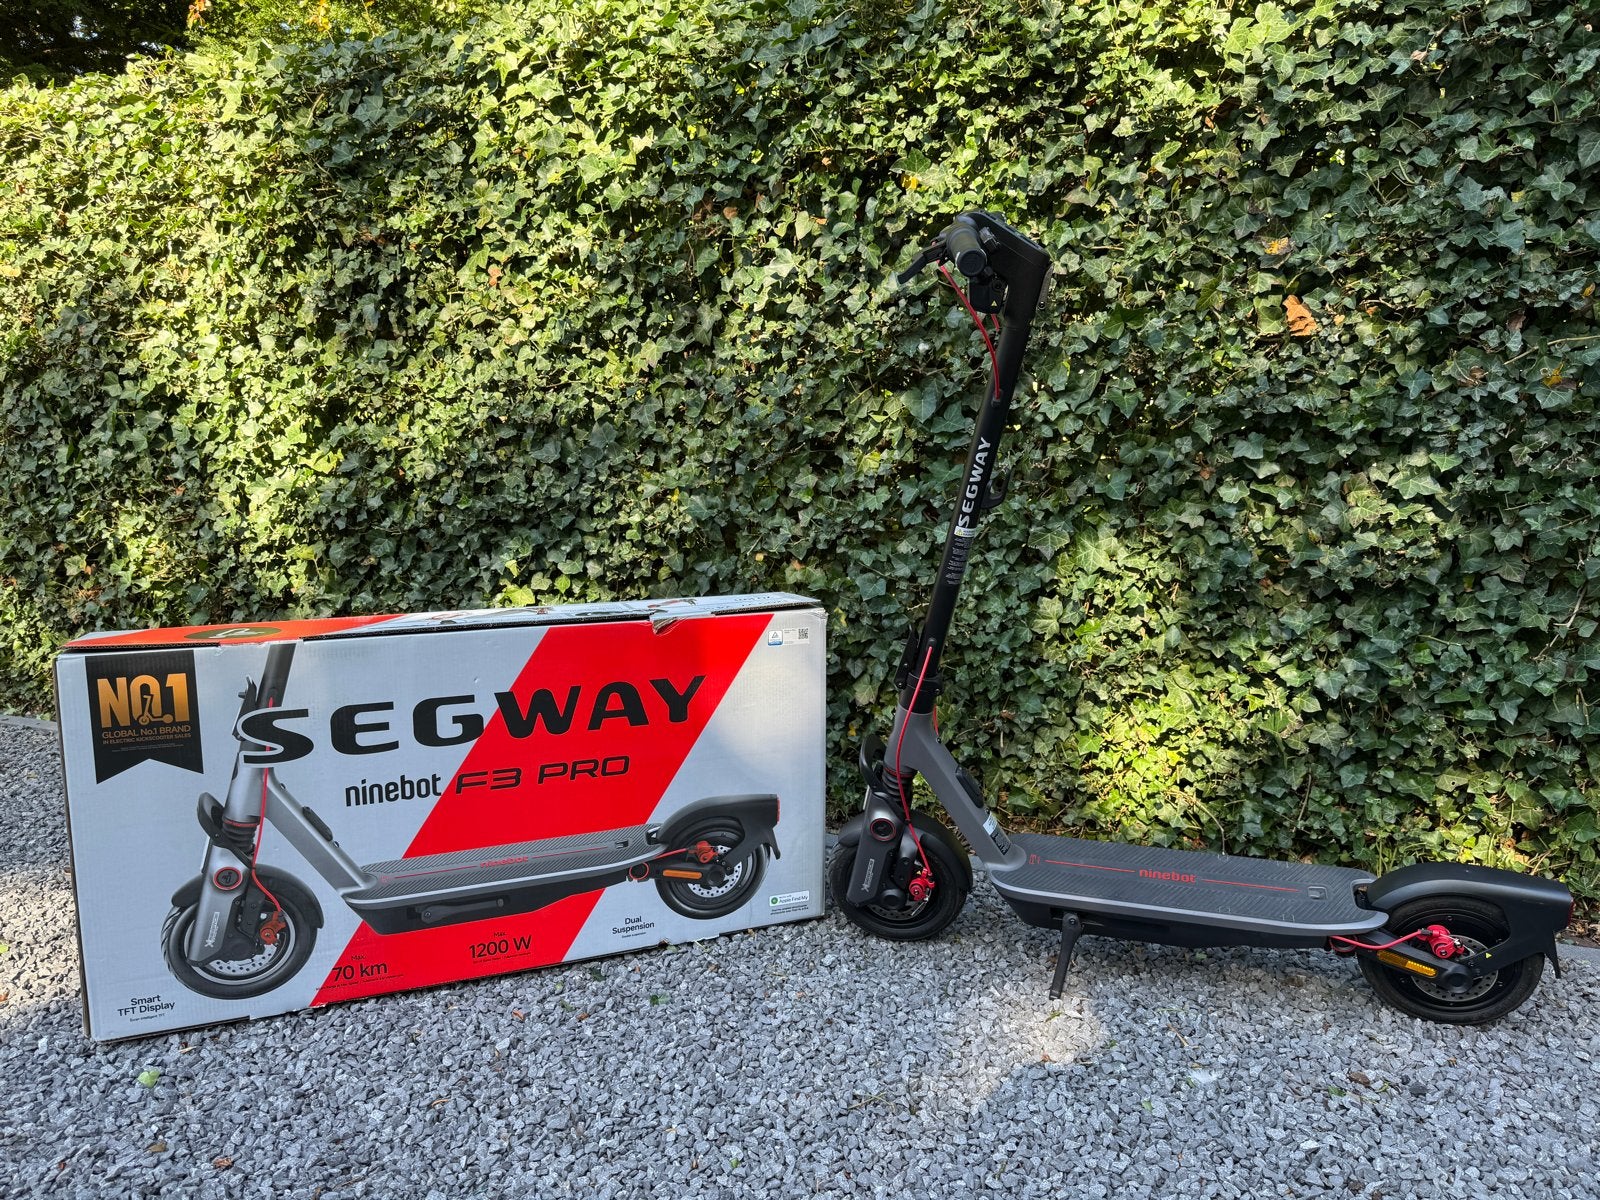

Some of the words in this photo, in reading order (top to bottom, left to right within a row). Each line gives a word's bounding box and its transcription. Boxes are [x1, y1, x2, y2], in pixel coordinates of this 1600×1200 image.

[957, 436, 991, 528] SEGWAY
[241, 675, 706, 764] SEGWAY
[102, 729, 139, 739] GLOBAL
[159, 724, 192, 735] BRAND
[344, 773, 442, 807] ninebot
[455, 767, 522, 795] F3
[538, 755, 630, 784] PRO
[1139, 868, 1197, 883] ninebot
[624, 915, 643, 925] Dual
[611, 921, 655, 935] Suspension
[469, 938, 509, 959] 1200
[512, 934, 532, 951] W
[332, 965, 355, 982] 70
[359, 962, 388, 977] km
[131, 995, 161, 1006] Smart
[117, 1007, 136, 1017] TFT
[139, 1002, 175, 1013] Display
